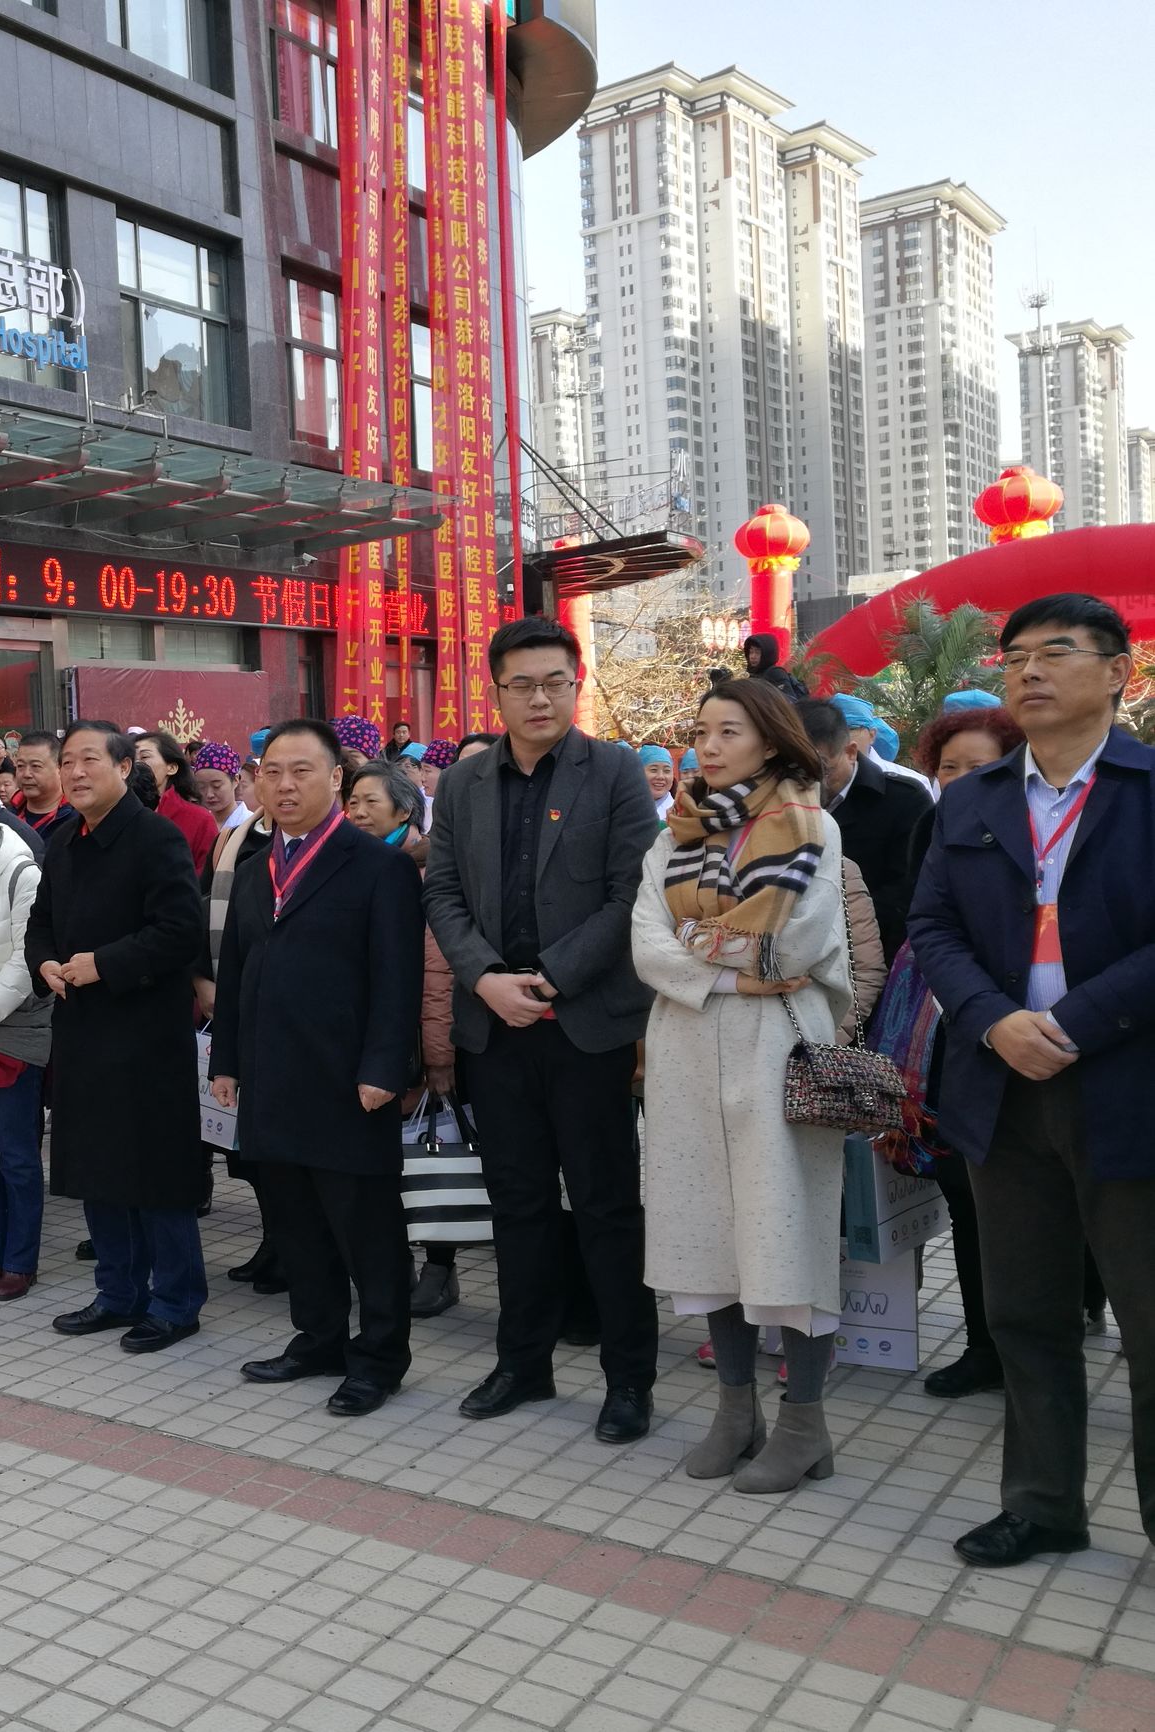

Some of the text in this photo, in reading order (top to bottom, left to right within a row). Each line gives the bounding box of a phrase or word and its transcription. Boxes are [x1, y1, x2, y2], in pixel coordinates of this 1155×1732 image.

[250, 575, 429, 636] 节假日营业
